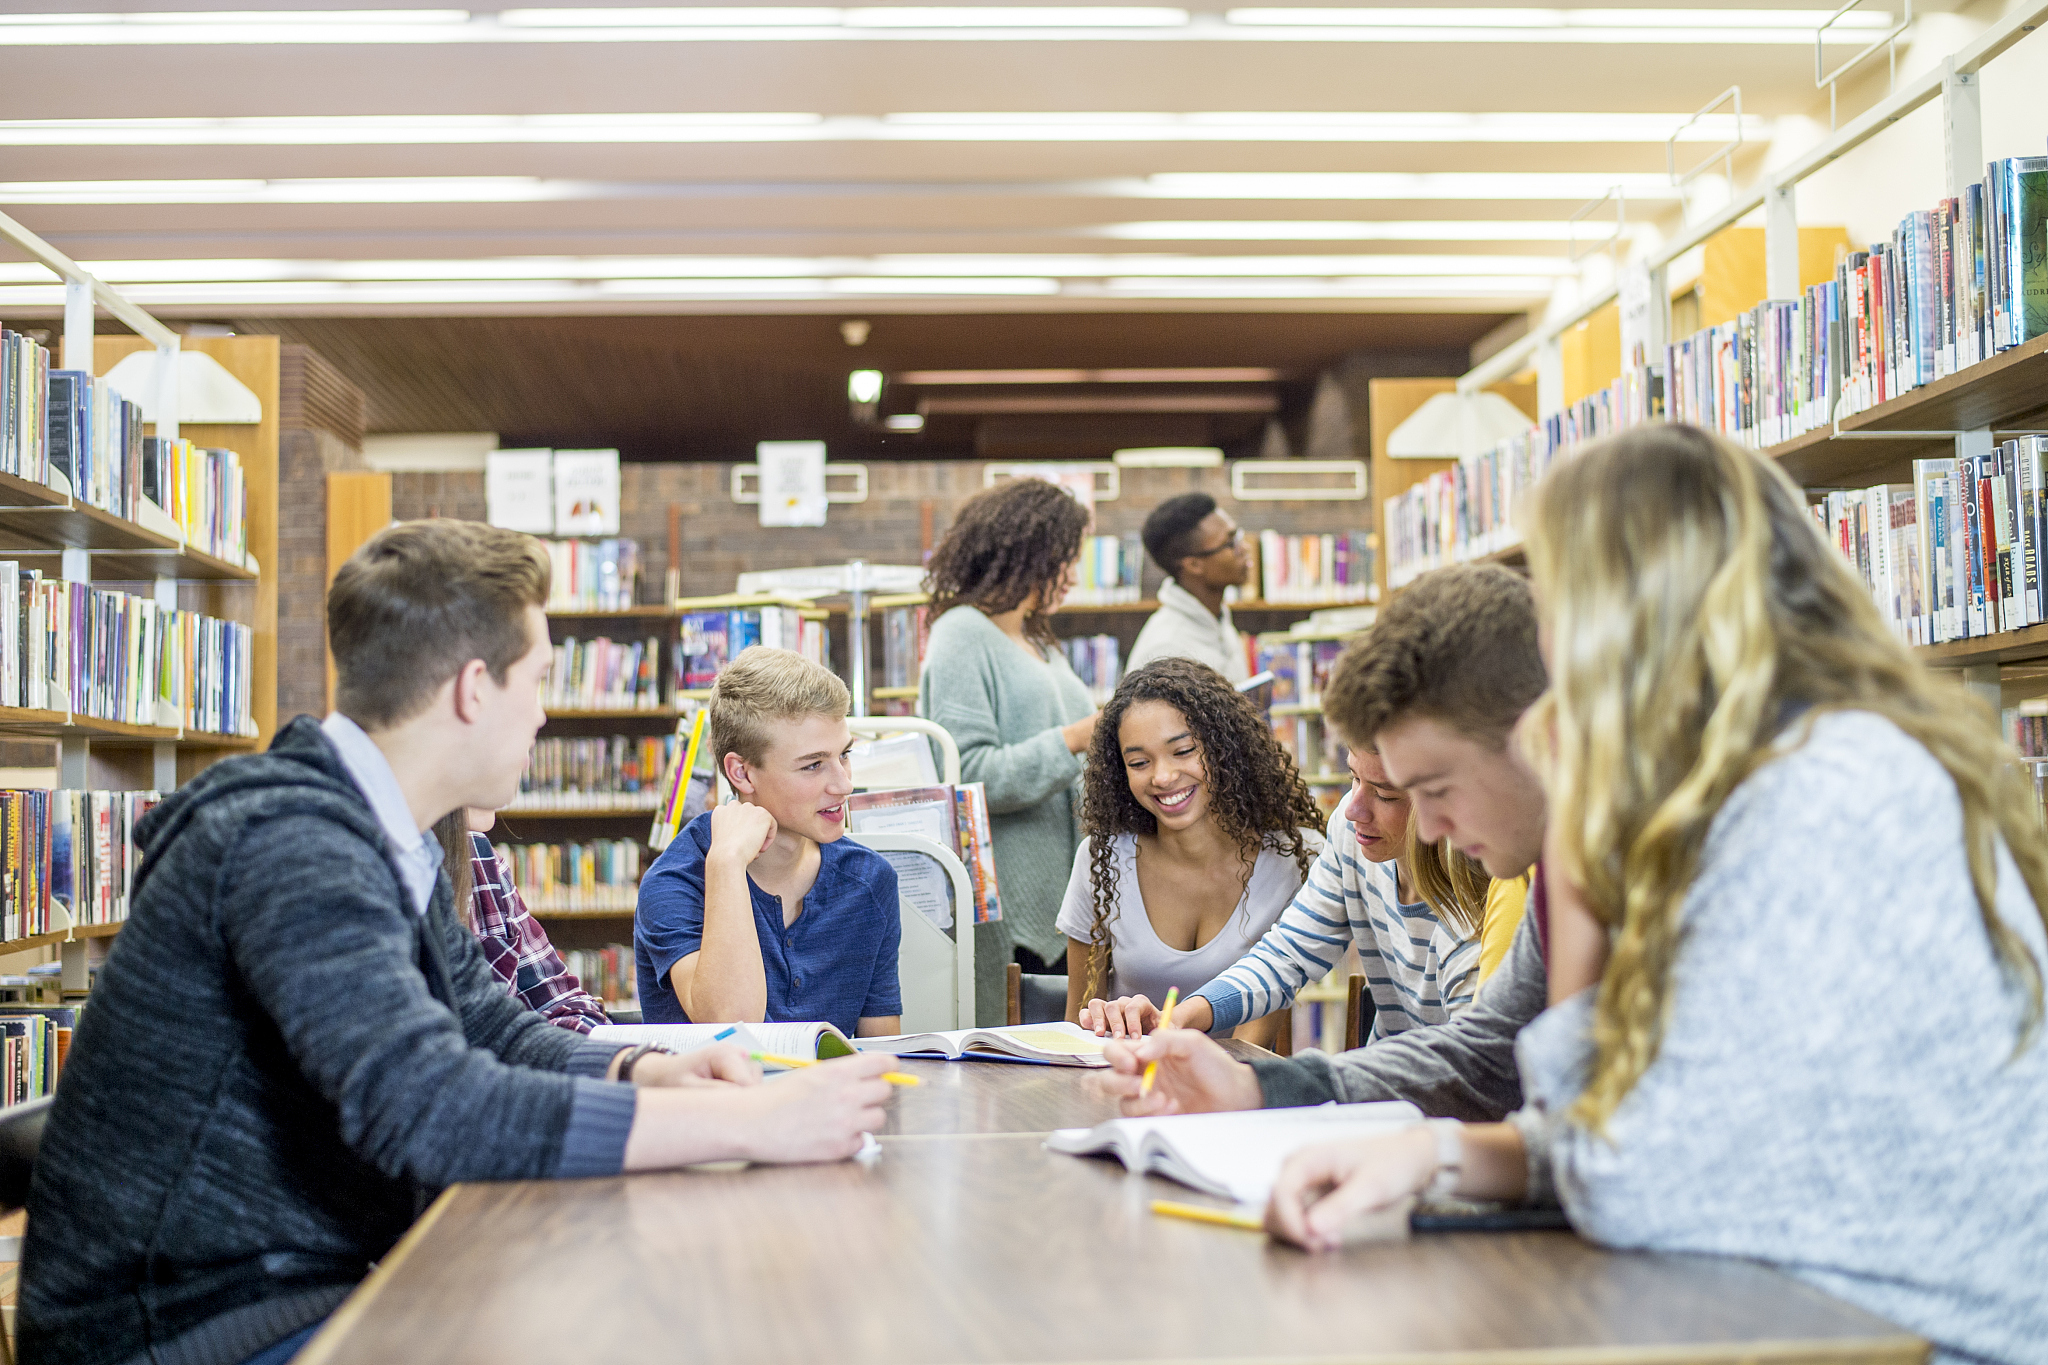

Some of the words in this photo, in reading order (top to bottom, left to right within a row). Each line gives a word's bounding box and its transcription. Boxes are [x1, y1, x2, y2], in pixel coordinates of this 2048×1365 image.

[1940, 203, 1949, 225] The
[1941, 226, 1950, 250] Last
[1942, 251, 1950, 297] Hostage
[2022, 458, 2030, 485] O'DELL
[2008, 509, 2016, 542] Coal
[2025, 549, 2036, 583] ROADS
